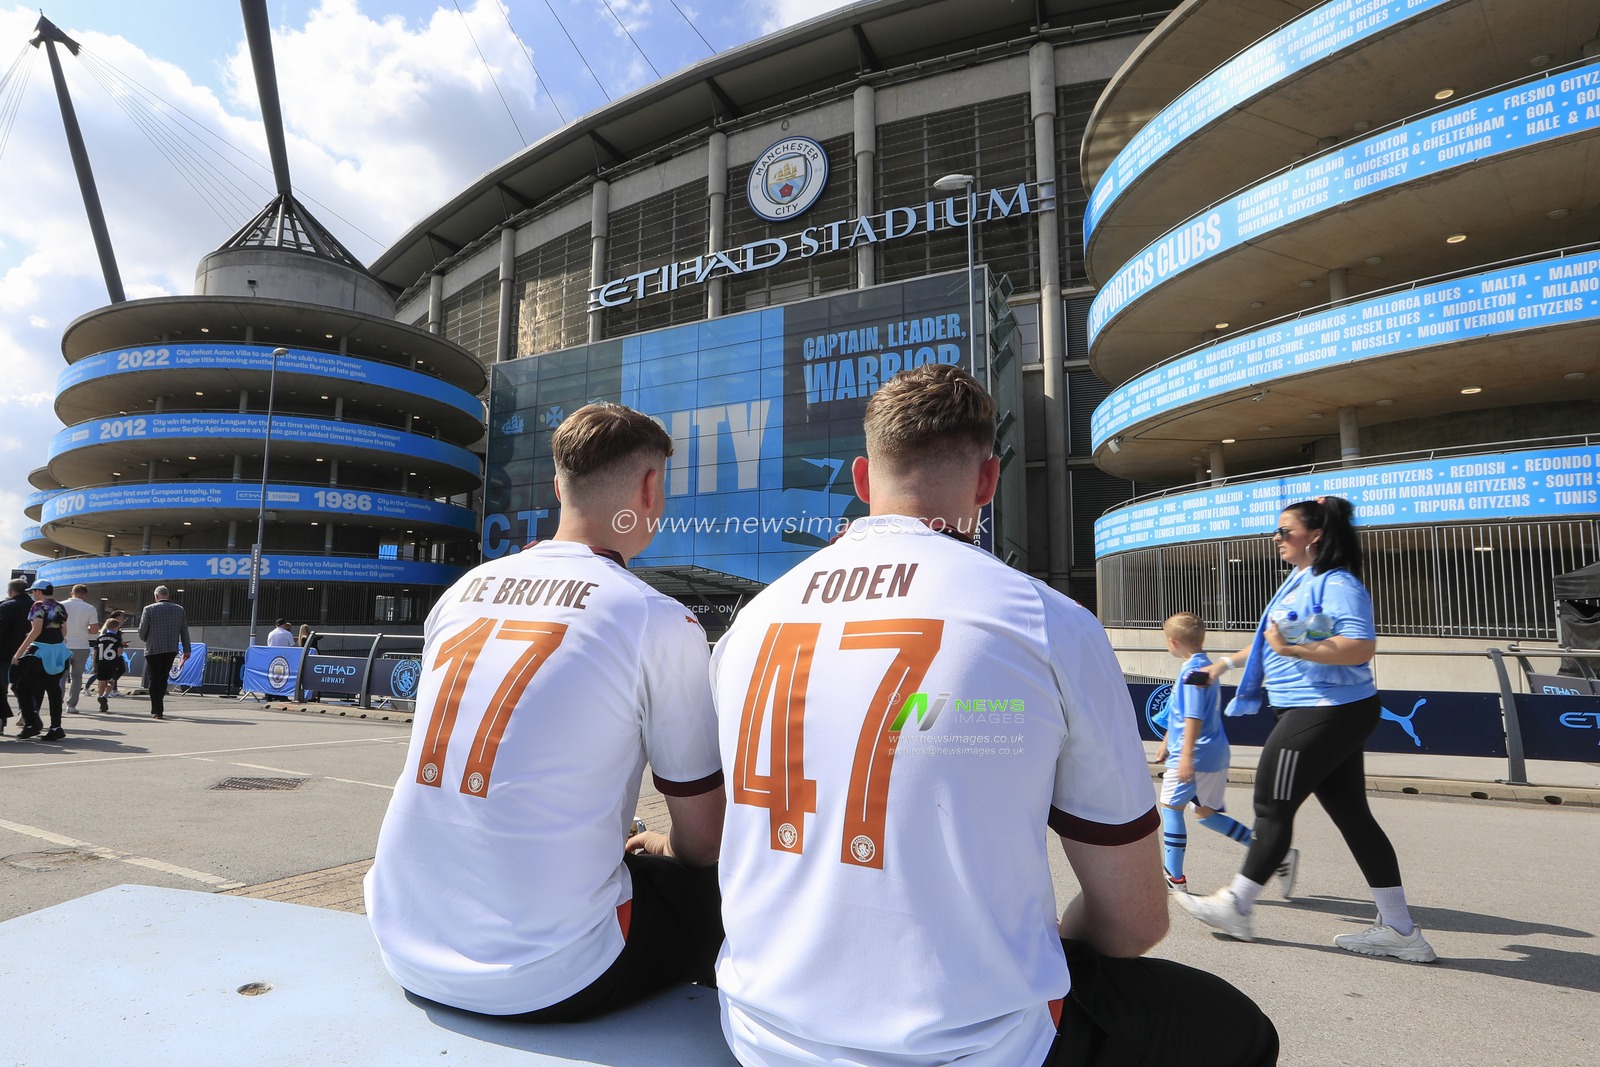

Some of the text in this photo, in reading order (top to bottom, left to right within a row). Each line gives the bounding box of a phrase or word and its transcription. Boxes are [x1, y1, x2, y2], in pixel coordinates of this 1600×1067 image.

[1288, 21, 1335, 55] BREDBURY
[1356, 9, 1389, 33] BLUES
[756, 142, 819, 176] MANCHESTER
[1237, 84, 1555, 211] FALLOWFIELD FINLAND FLIXTON FRANCE FRESNO
[1237, 101, 1554, 223] GIBRALTAR GILFORD GLOUCESTER & CHELTENHAM GOA
[1237, 111, 1578, 237] GUATEMALA CITYZENS GUERNSEY GUIYANG HALE &
[775, 203, 799, 215] CITY
[598, 237, 788, 308] ETIHAD
[801, 182, 1031, 259] STADIUM
[1093, 213, 1221, 326] SUPPORTERS CLUBS
[1194, 277, 1599, 381] MEXICO CITY MID CHESHIRE MID SUSSEX BLUES MIDDLETON MILANO
[1206, 274, 1527, 364] MACCLESFIELD BLUES MACHAKOS MALLORCA BLUES MALTA
[803, 313, 967, 361] CAPTAIN, LEADER,
[1209, 297, 1583, 389] MOROCCAN CITYZENS MOSCOW MOSSLEY MOUNT VERNON CITYZENS
[117, 348, 170, 370] 2022
[176, 349, 190, 357] City
[319, 357, 336, 366] sixth
[336, 360, 362, 370] Premier
[176, 357, 200, 365] League
[216, 357, 248, 366] following
[277, 361, 309, 369] dramatic
[309, 364, 328, 373] flurry
[350, 370, 367, 378] goals
[100, 418, 147, 440] 2012
[153, 419, 167, 427] City
[221, 419, 247, 427] League
[333, 426, 357, 435] historic
[377, 433, 401, 441] moment
[181, 426, 203, 434] Sergio
[204, 425, 230, 434] Agüero
[284, 429, 299, 437] goal
[307, 430, 329, 438] added
[329, 433, 345, 441] time
[648, 400, 770, 496] ITY
[151, 488, 182, 496] European
[1193, 510, 1211, 521] SOUTH
[1212, 505, 1240, 518] FLORIDA
[1249, 501, 1274, 513] SOUTH
[1362, 487, 1397, 503] SOUTH
[1399, 482, 1462, 500] MORAVIAN
[1465, 477, 1526, 495] CITYZENS
[1545, 471, 1593, 488] SOUTH
[1215, 491, 1243, 505] RALEIGH
[1253, 482, 1311, 499] RAMSBOTTOM
[1324, 474, 1379, 491] REDBRIDGE
[1381, 468, 1433, 485] CITYZENS
[1450, 461, 1505, 478] REDDISH
[1525, 454, 1592, 472] REDONDO
[55, 494, 85, 516] 1970
[180, 496, 205, 504] League
[207, 496, 222, 504] Cup
[314, 490, 372, 511] 1986
[1210, 490, 1597, 531] TOKYO TORONTO TOBAGO TRIPURA CITYZENS TUNIS
[107, 559, 188, 569] Cup final Crystal Palace,
[122, 568, 163, 577] major trophy
[278, 560, 293, 568] City
[323, 561, 343, 569] Maine
[290, 568, 312, 576] Club's
[343, 569, 354, 577] the
[460, 576, 600, 610] DE BRUYNE
[801, 563, 919, 605] FODEN
[98, 643, 117, 660] 16
[313, 664, 356, 676] ETIHAD
[416, 617, 569, 799] 17
[733, 618, 945, 869] 47
